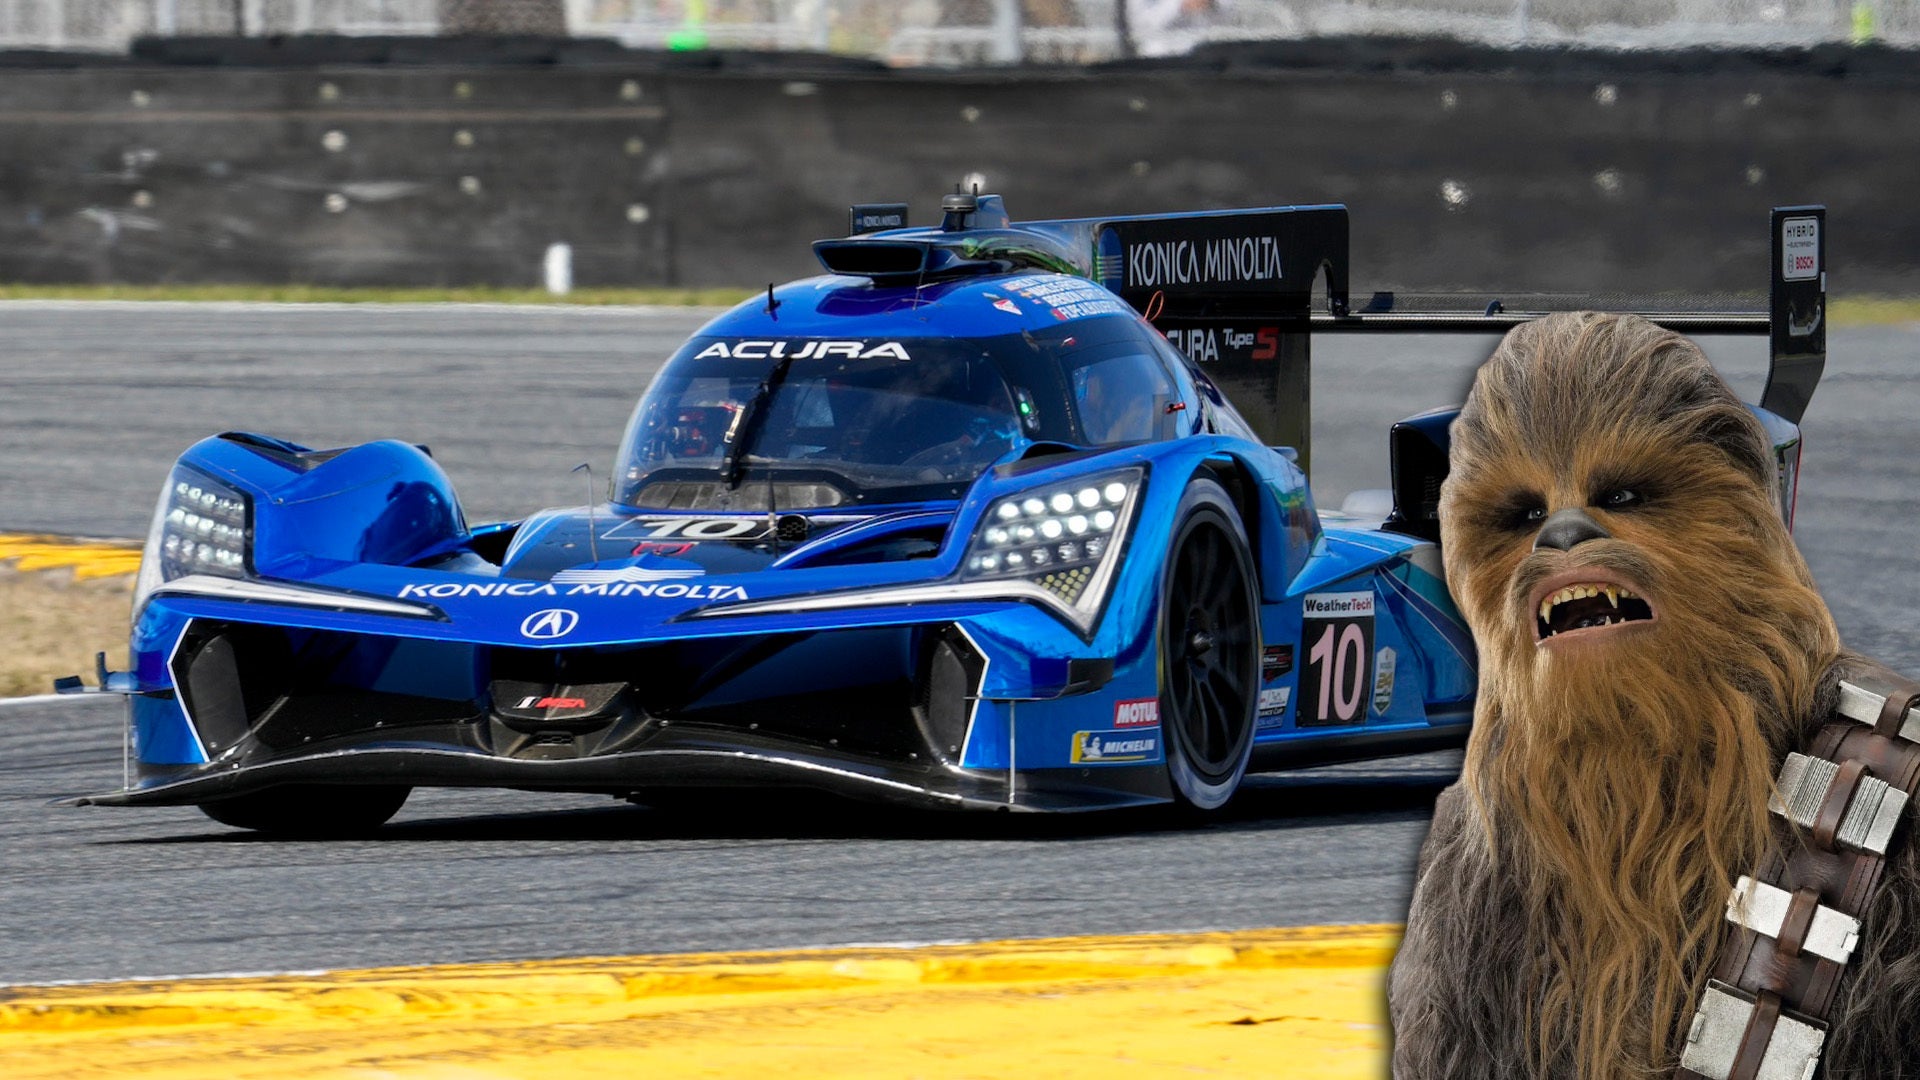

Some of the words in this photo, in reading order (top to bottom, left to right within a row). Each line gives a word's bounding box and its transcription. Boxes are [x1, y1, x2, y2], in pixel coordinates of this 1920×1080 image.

[1129, 240, 1200, 287] KONICA
[1204, 236, 1283, 282] MINOLTA
[1796, 256, 1814, 269] BOSCH
[694, 341, 911, 360] ACURA
[1223, 328, 1254, 349] Type
[1252, 327, 1279, 359] S
[643, 519, 757, 537] 10
[397, 583, 557, 598] KONICA
[566, 583, 748, 600] MINOLTA
[1305, 597, 1373, 612] WeatherTech
[1309, 623, 1364, 720] 10
[1116, 701, 1158, 724] MOTUL
[1103, 739, 1155, 753] MICHELIN
